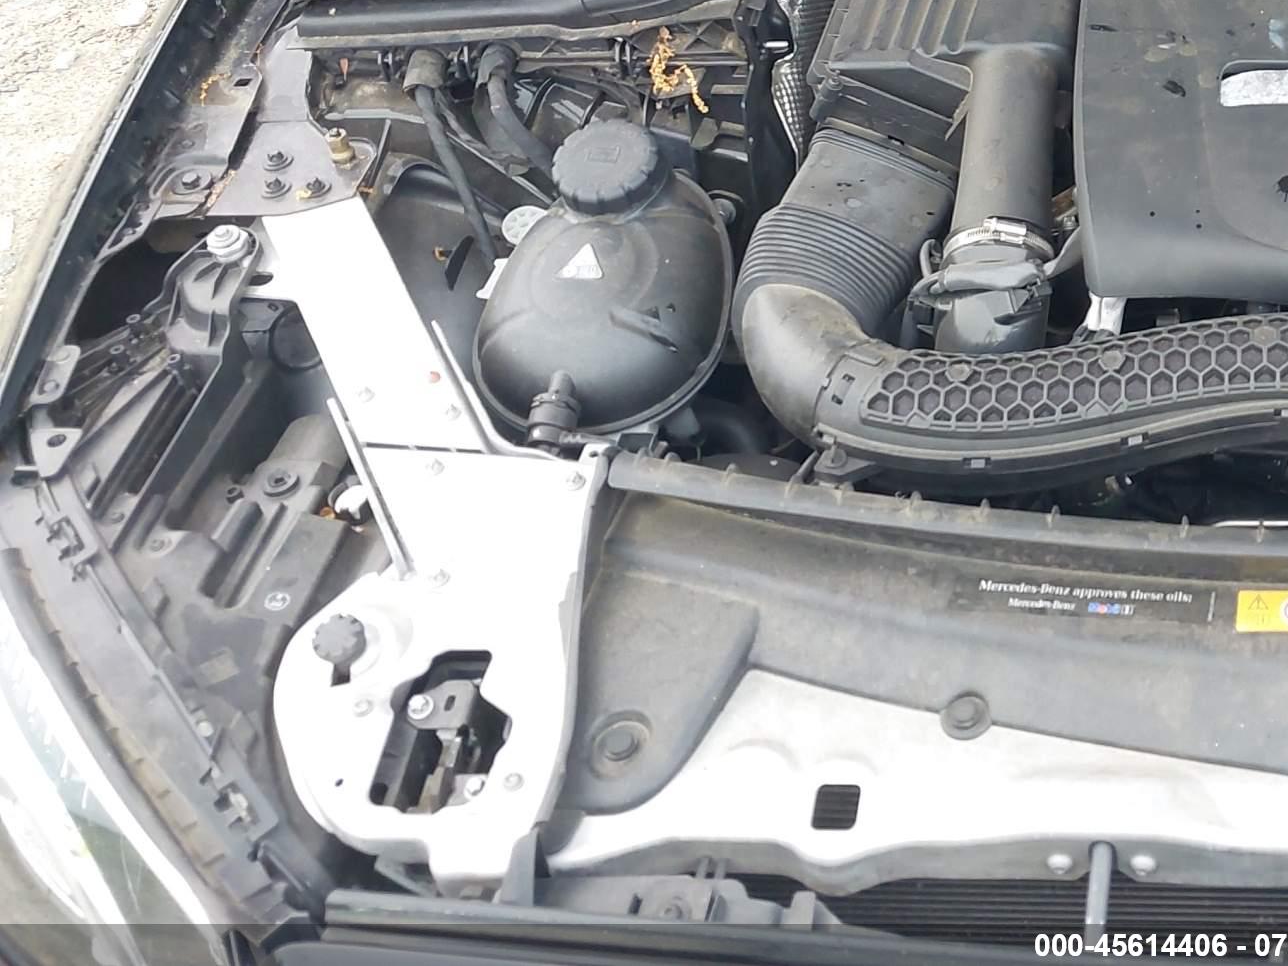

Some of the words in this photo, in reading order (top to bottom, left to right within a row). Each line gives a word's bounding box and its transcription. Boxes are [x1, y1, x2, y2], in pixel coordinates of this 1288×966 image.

[979, 579, 1071, 596] Mercedes-Benz
[1072, 586, 1128, 600] approves
[1130, 588, 1164, 601] these
